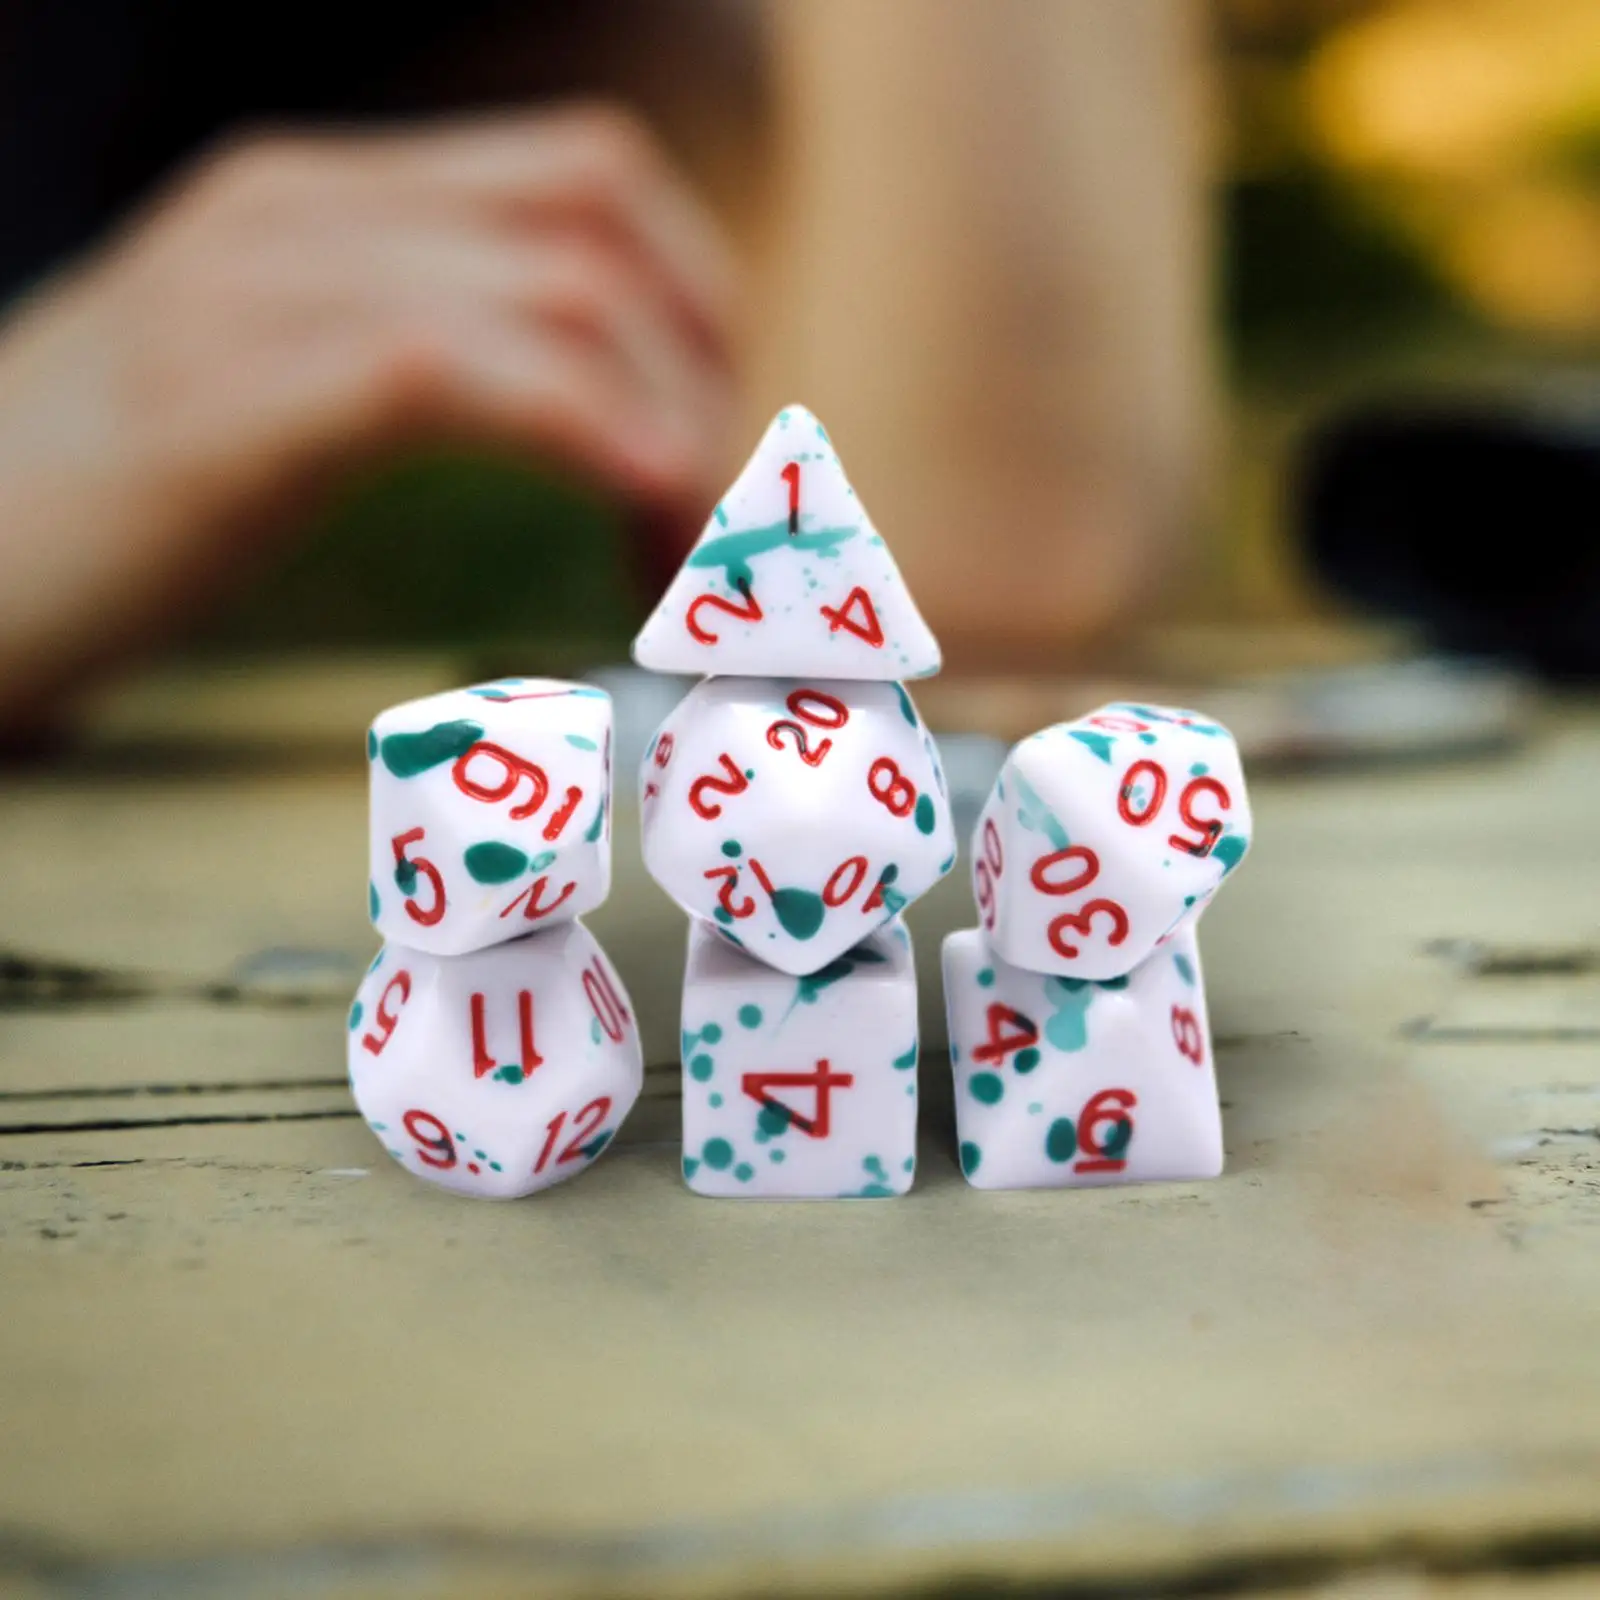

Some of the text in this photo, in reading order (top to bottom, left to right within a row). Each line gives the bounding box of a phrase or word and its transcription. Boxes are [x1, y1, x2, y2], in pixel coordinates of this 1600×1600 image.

[779, 461, 801, 537] 1
[685, 576, 764, 646] 2
[819, 586, 886, 649] 4
[765, 687, 850, 768] 20
[688, 752, 750, 822] 2
[867, 756, 919, 819] 8
[1116, 758, 1233, 858] 50
[391, 826, 447, 928] 5
[1030, 845, 1131, 960] 30
[361, 968, 412, 1057] 5
[469, 989, 545, 1080] 11
[971, 1003, 1039, 1068] 4
[1171, 1004, 1204, 1067] 8
[533, 1095, 613, 1174] 12
[740, 1057, 856, 1140] 4
